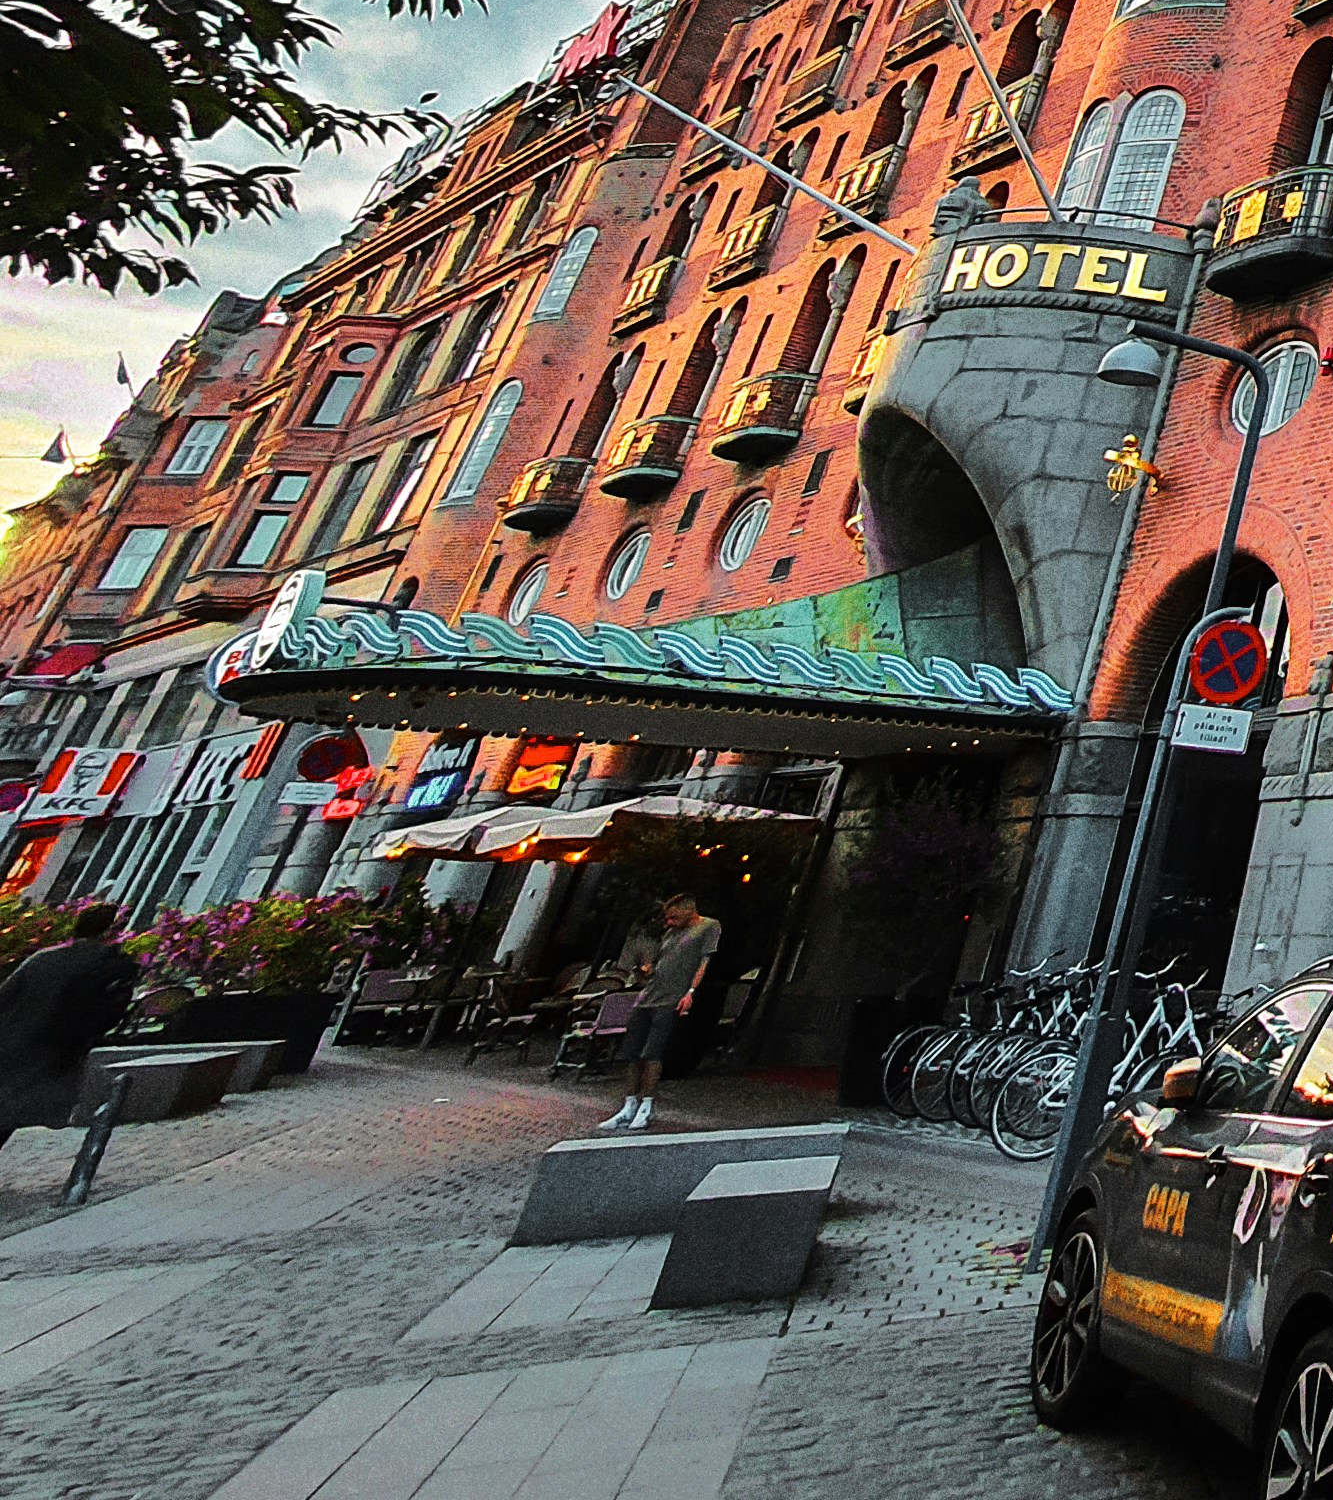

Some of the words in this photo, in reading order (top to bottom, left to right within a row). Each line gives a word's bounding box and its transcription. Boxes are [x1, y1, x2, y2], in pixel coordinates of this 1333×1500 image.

[940, 242, 1168, 303] HOTEL
[41, 797, 98, 811] KFC
[1142, 1182, 1191, 1237] CAPA
